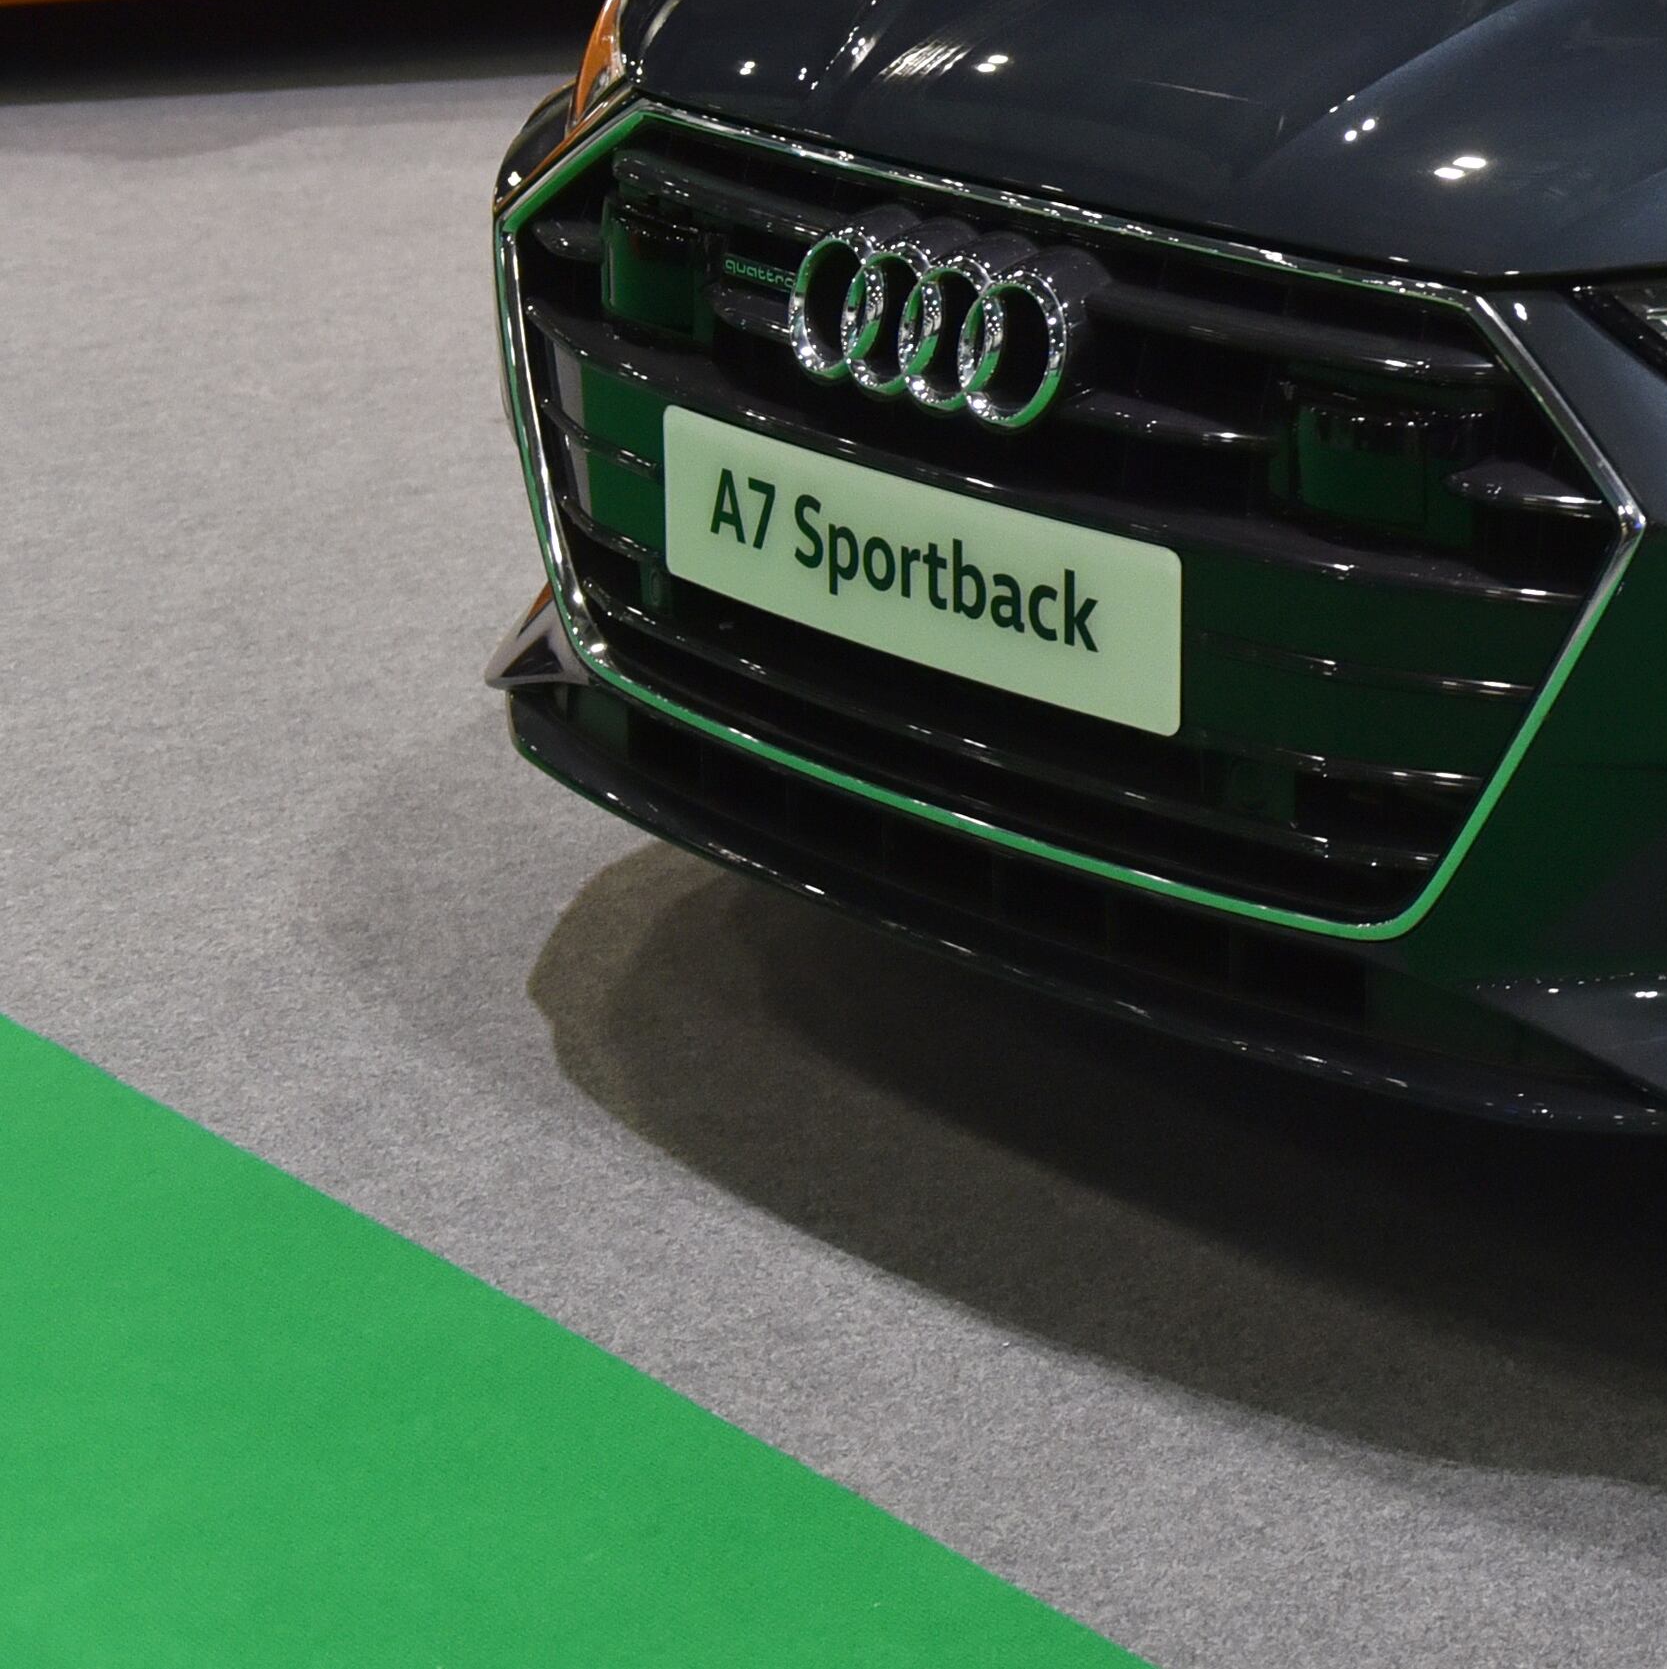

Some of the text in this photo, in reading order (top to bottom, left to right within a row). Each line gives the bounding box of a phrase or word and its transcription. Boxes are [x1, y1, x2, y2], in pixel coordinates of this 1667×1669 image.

[725, 259, 797, 289] quattro
[710, 467, 1100, 653] A7 Sportback
